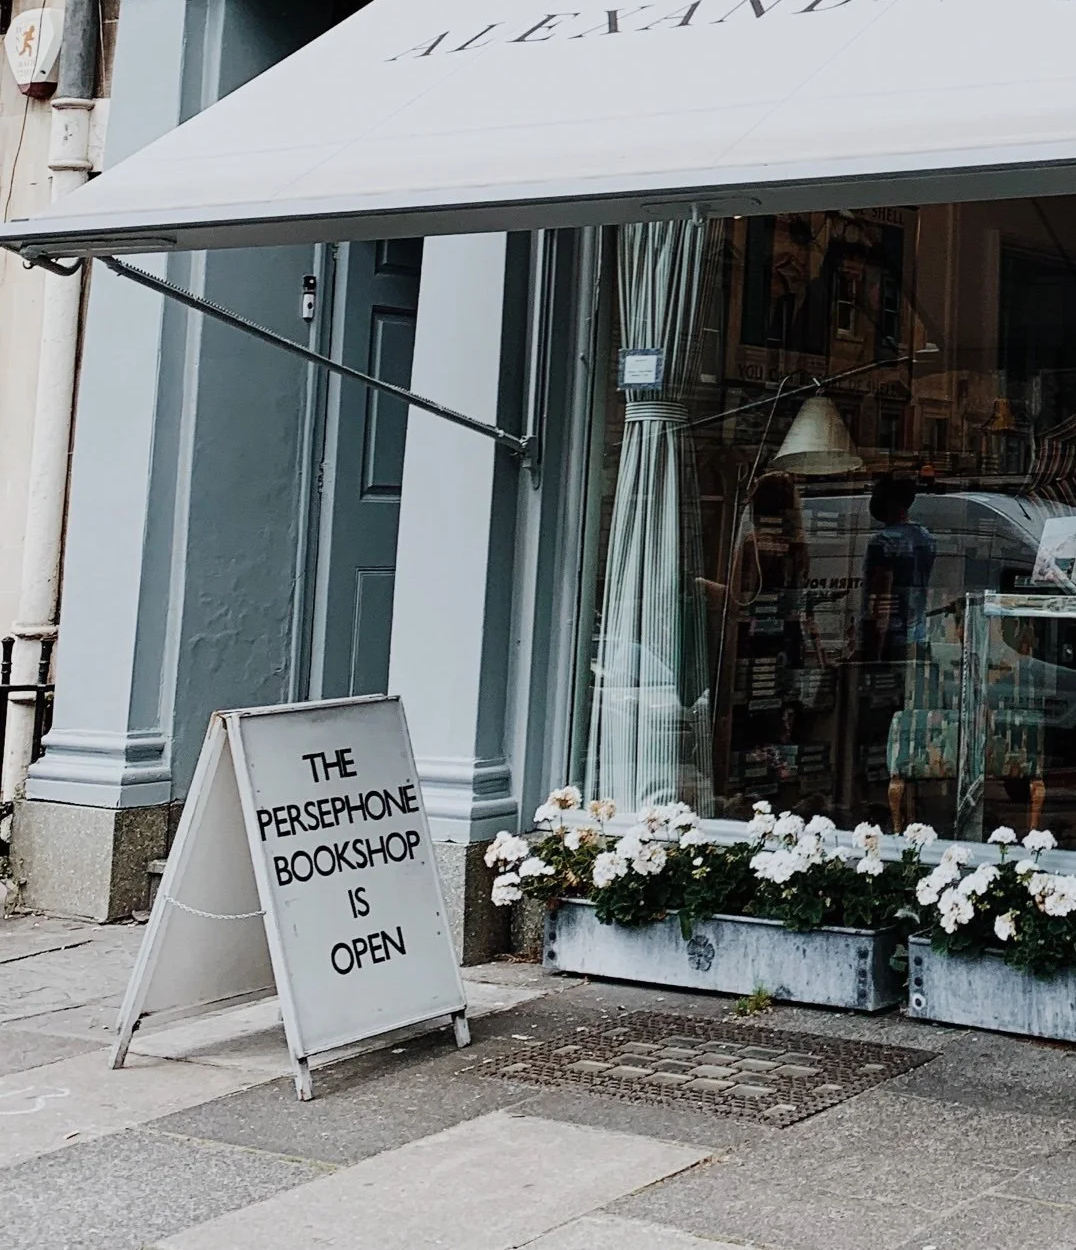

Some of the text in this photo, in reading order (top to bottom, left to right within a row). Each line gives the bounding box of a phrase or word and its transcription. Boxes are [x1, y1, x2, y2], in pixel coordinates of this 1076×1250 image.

[302, 748, 357, 783] THE
[256, 784, 419, 841] PERSEPHONE
[273, 830, 420, 886] BOOKSHOP
[348, 887, 370, 919] IS
[331, 926, 407, 975] OPEN
